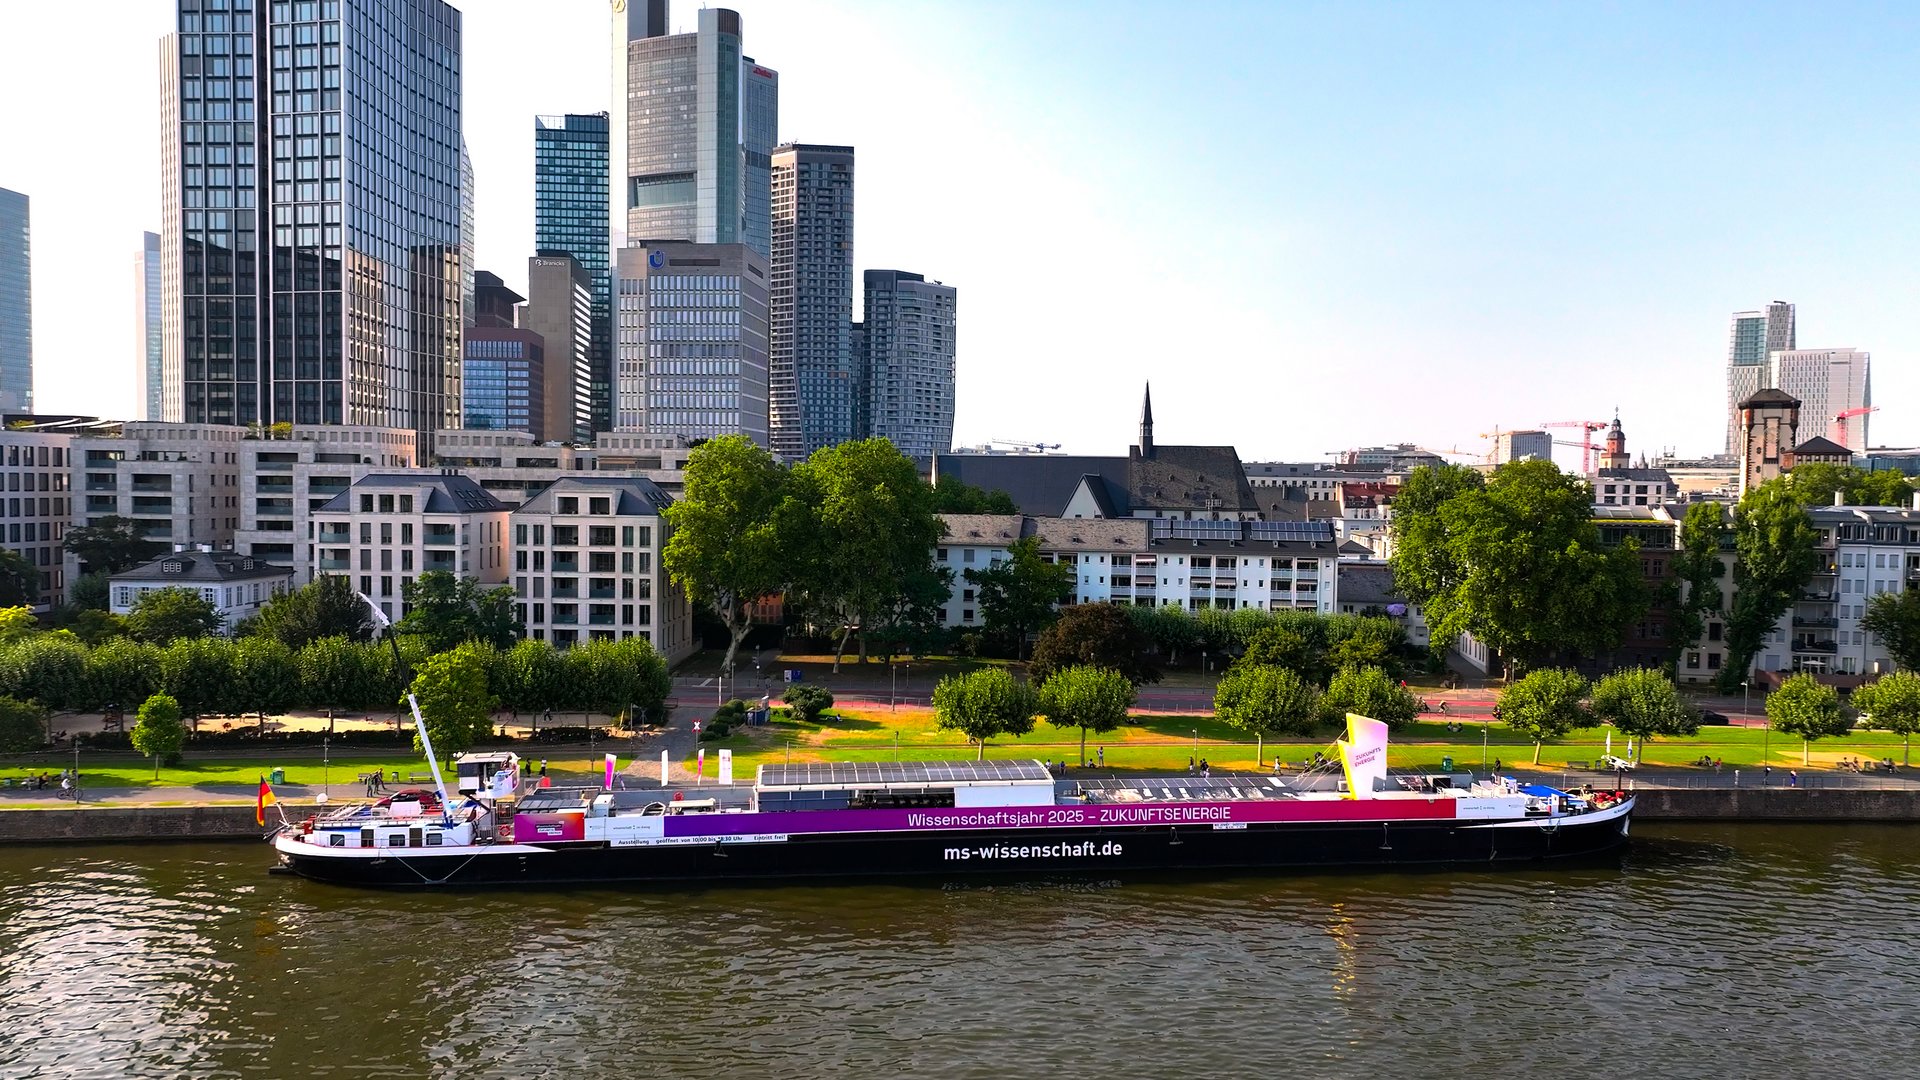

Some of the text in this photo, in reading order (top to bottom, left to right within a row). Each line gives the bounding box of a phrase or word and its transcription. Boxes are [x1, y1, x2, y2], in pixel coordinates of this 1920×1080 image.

[1354, 755, 1375, 767] ENERGIE
[908, 811, 1045, 827] Wissenschaftsjahr
[1049, 810, 1084, 823] 2025
[1100, 806, 1231, 822] ZUKUNFTSENERGIE
[944, 841, 1123, 860] ms-wissenschaft.de
